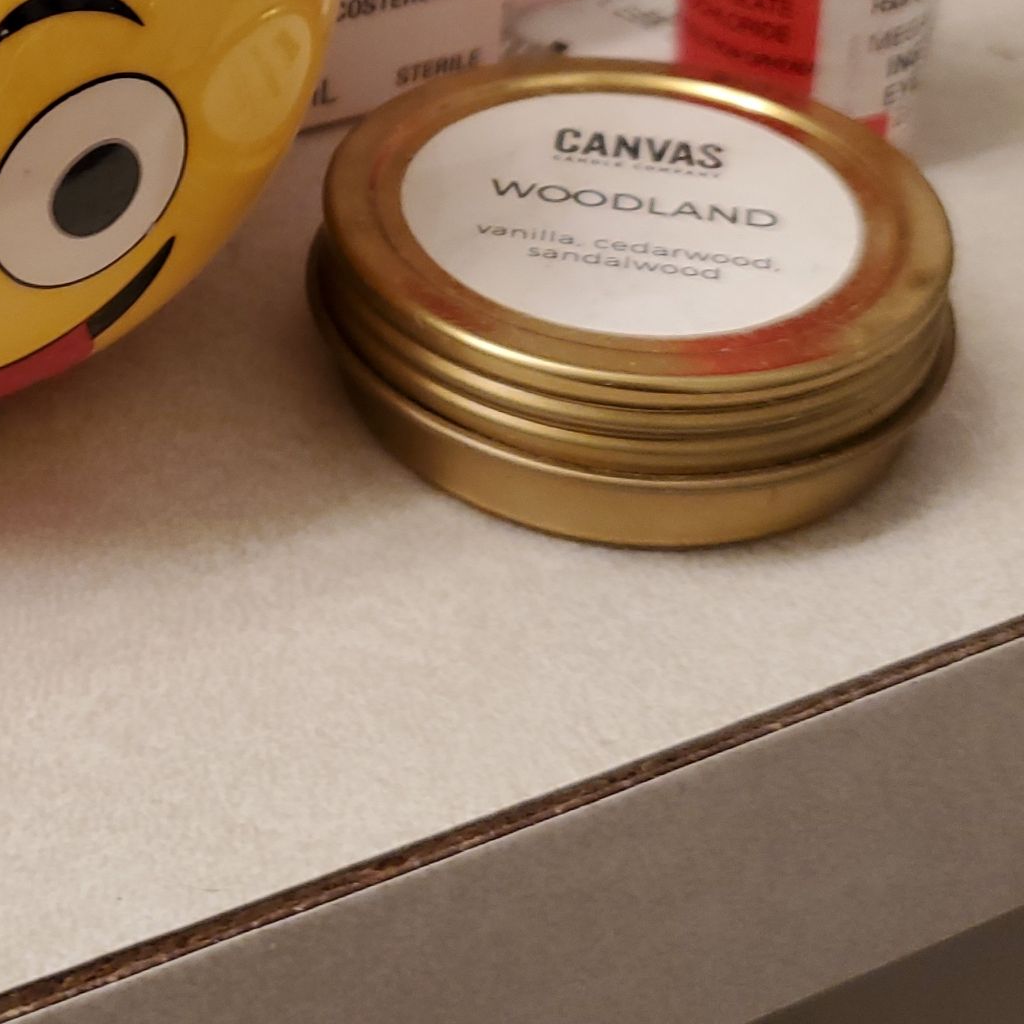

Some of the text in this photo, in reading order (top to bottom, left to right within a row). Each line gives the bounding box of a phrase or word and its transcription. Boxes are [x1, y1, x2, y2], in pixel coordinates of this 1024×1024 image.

[395, 48, 482, 87] STERILE
[554, 127, 725, 170] CANVAS
[491, 178, 779, 229] WOODLAND
[527, 244, 721, 281] sandalwood
